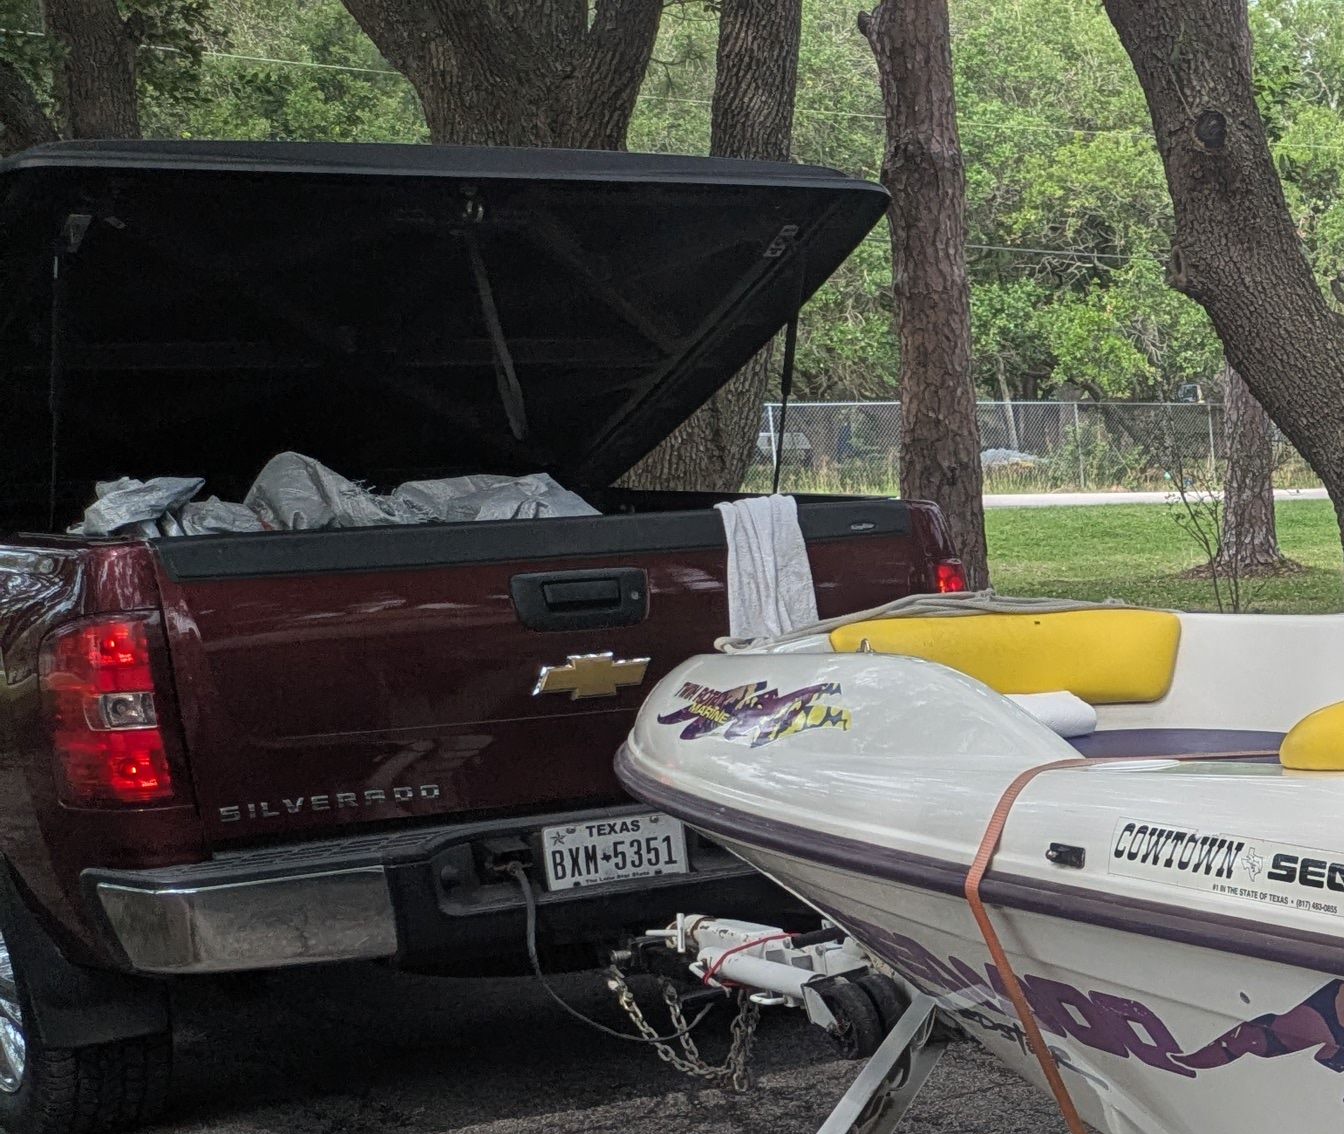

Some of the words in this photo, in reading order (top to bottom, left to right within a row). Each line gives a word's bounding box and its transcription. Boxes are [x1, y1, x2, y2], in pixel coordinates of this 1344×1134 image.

[688, 702, 730, 725] MARINE
[219, 784, 440, 822] SILVERADO
[585, 820, 641, 838] TEXAS
[551, 844, 599, 881] BXM
[612, 835, 677, 870] 5351
[1113, 822, 1245, 879] COWTOWN
[1227, 886, 1239, 895] THE
[1240, 888, 1258, 900] STATE
[1260, 890, 1268, 900] OF
[1269, 893, 1289, 905] TEXAS
